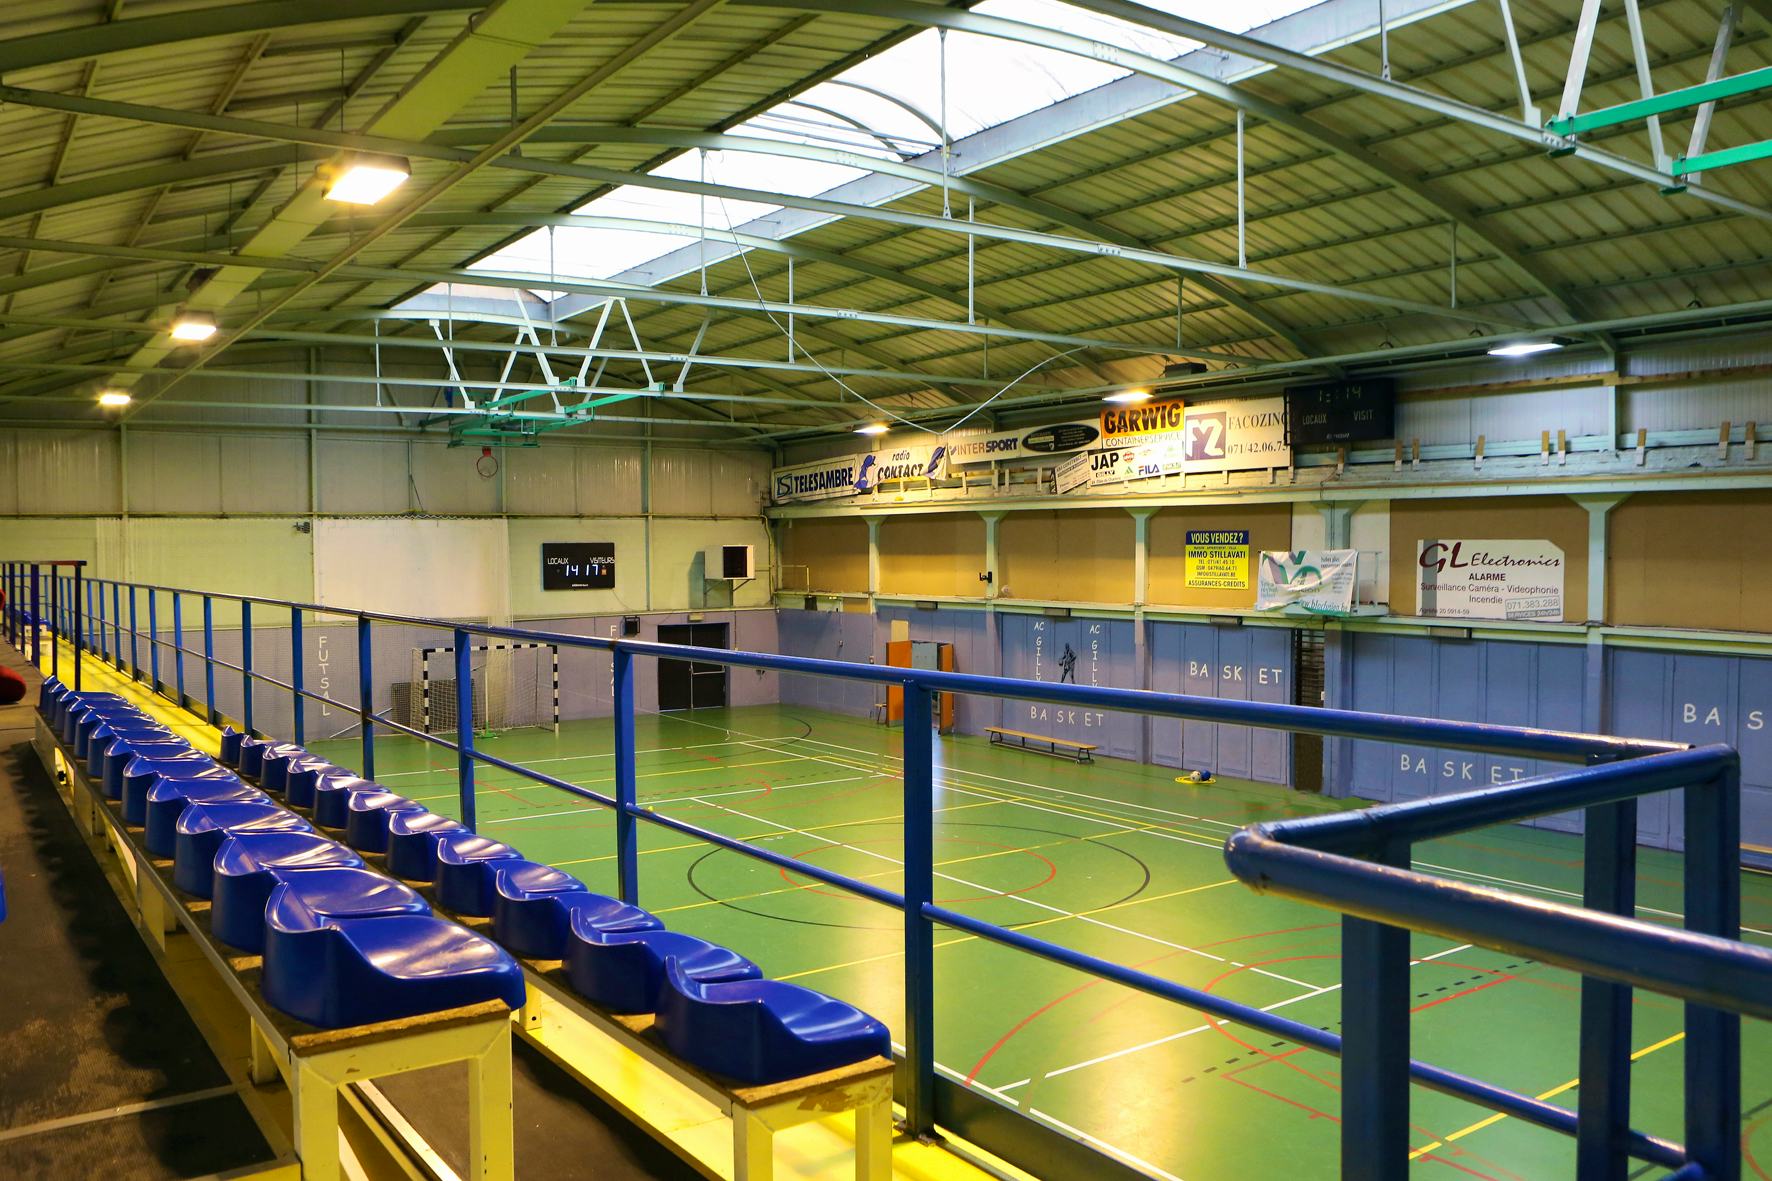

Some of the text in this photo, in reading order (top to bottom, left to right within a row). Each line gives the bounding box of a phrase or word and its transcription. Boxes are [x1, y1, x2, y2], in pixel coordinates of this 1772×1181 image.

[1104, 403, 1180, 434] GARWIG
[1303, 409, 1374, 425] LOCAUX VISIT
[957, 438, 1018, 455] INTERSPORT
[892, 450, 910, 461] radio
[1091, 452, 1119, 471] JAP
[878, 463, 924, 482] CONTACT
[1138, 463, 1160, 475] FILA
[794, 467, 854, 494] TELESAMBRE
[1191, 532, 1210, 543] VOUS
[1210, 532, 1238, 543] VENDEZ
[548, 557, 569, 565] LOCAUX
[1419, 542, 1560, 573] GL Electronics
[566, 564, 598, 576] 14 17
[1469, 573, 1506, 581] ALARME
[1420, 583, 1466, 592] Surveillance
[1468, 583, 1499, 593] Caméra
[1469, 595, 1503, 604] Incendie
[1034, 622, 1044, 631] AC
[1090, 624, 1100, 634] AC
[319, 635, 331, 716] FUTSAL
